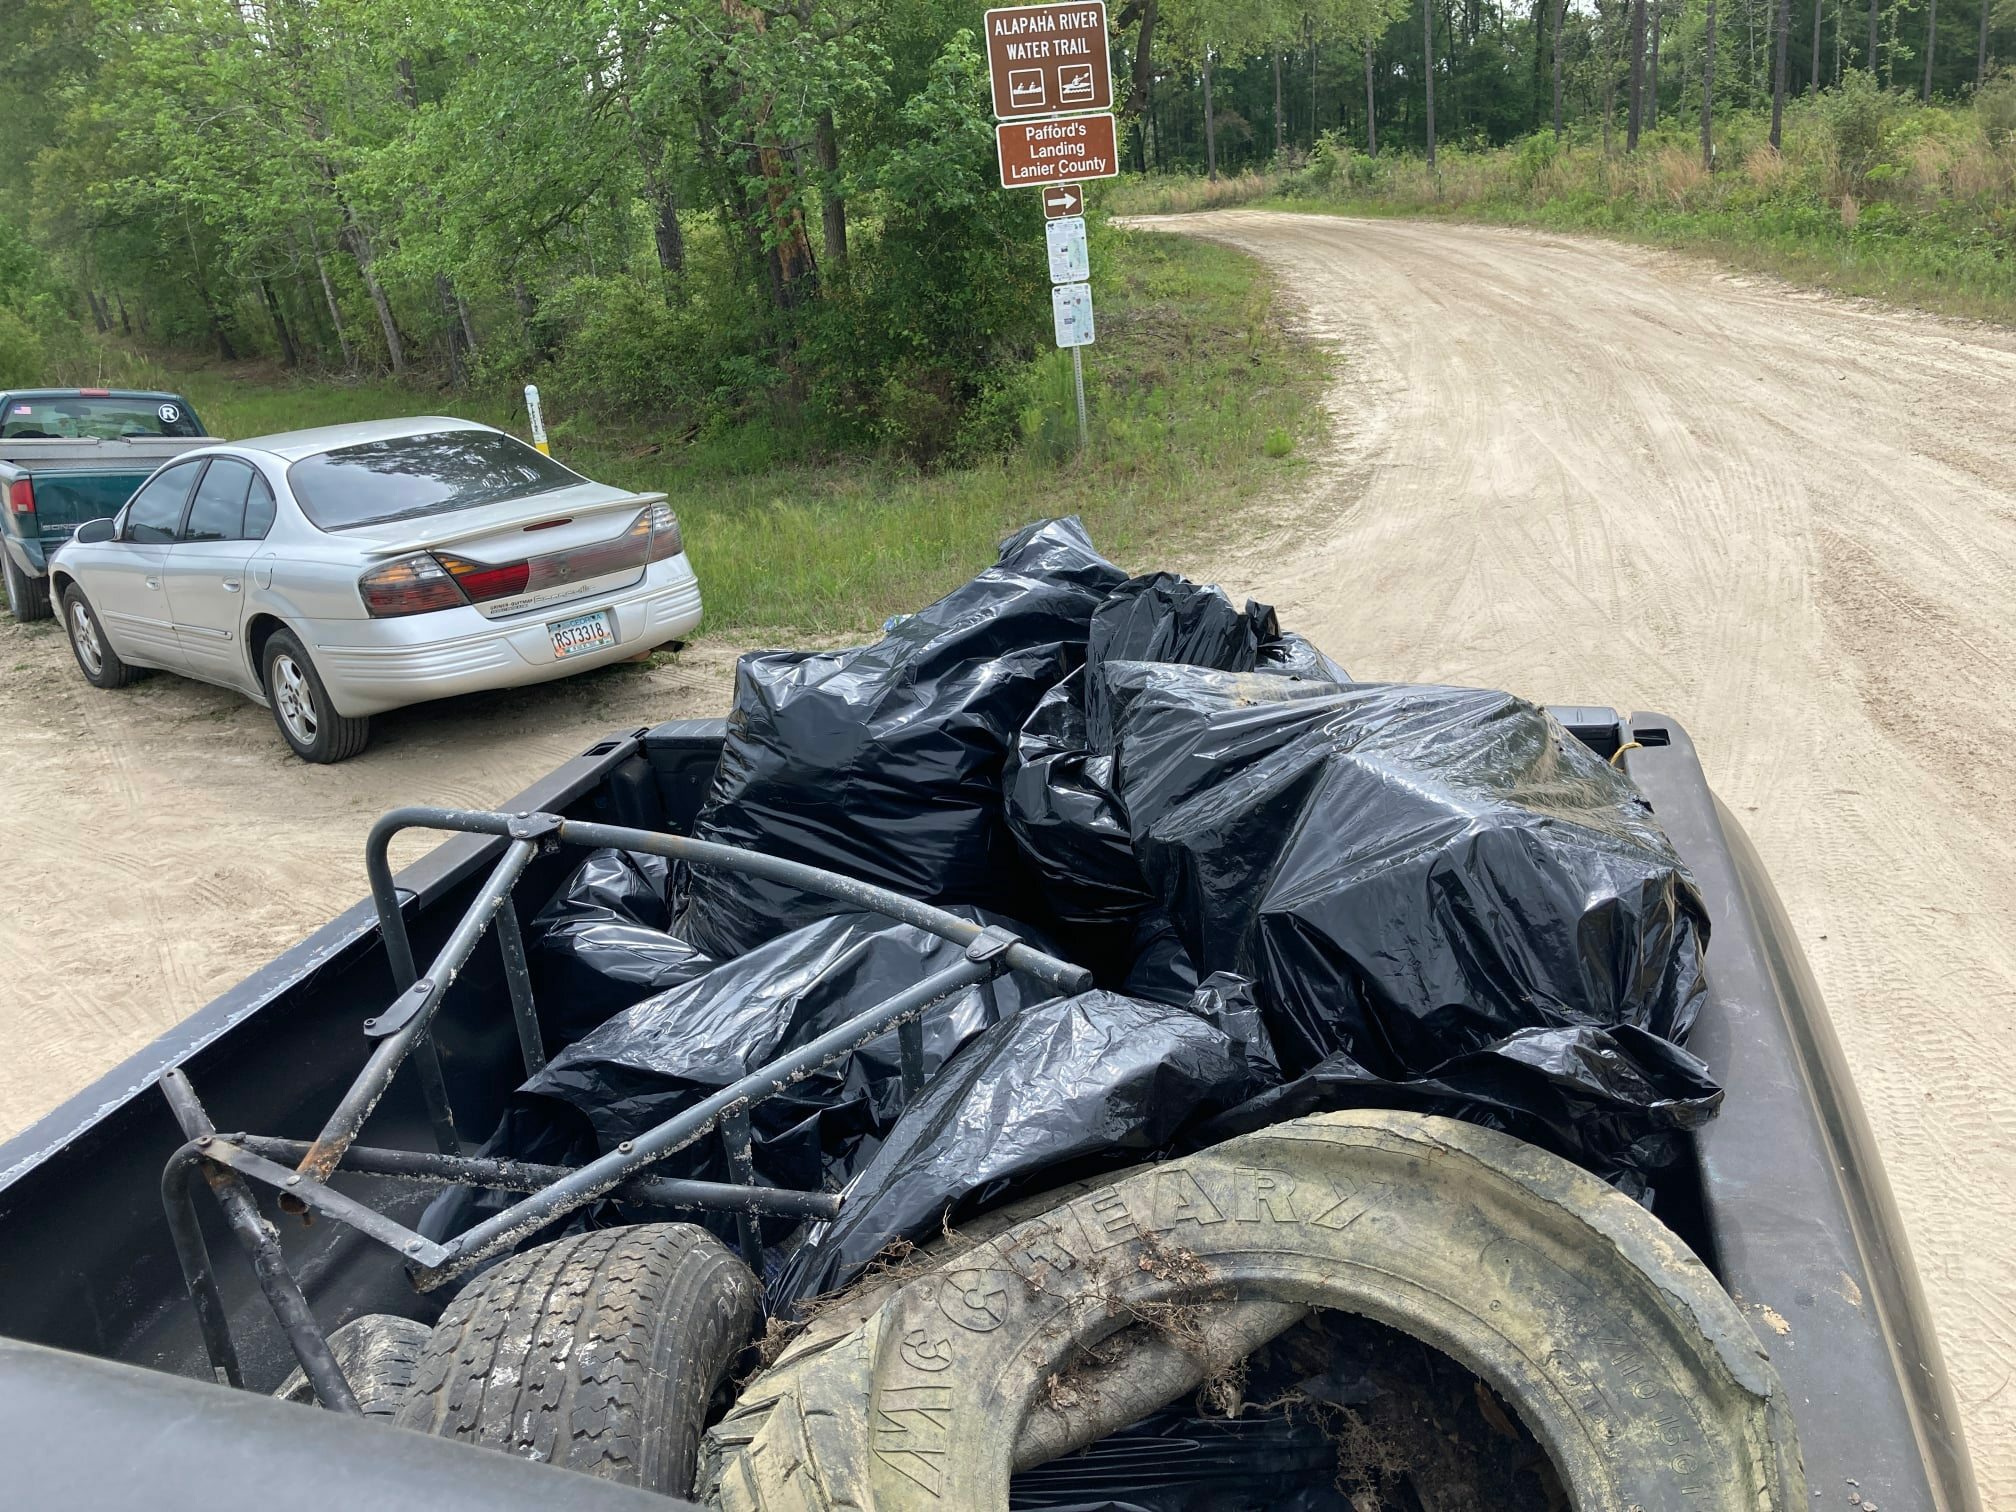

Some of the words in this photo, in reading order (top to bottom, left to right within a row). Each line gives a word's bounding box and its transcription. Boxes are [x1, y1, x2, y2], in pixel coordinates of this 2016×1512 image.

[994, 14, 1056, 36] ALAPAHA
[1059, 11, 1098, 30] RIVER
[1006, 41, 1050, 60] WATER
[1053, 37, 1091, 56] TRAIL
[1025, 122, 1087, 141] Pafford's
[1030, 142, 1085, 158] Landing
[1011, 162, 1055, 179] Lanier
[1058, 157, 1106, 174] County
[569, 614, 603, 626] GEORA
[555, 622, 604, 649] RST3318
